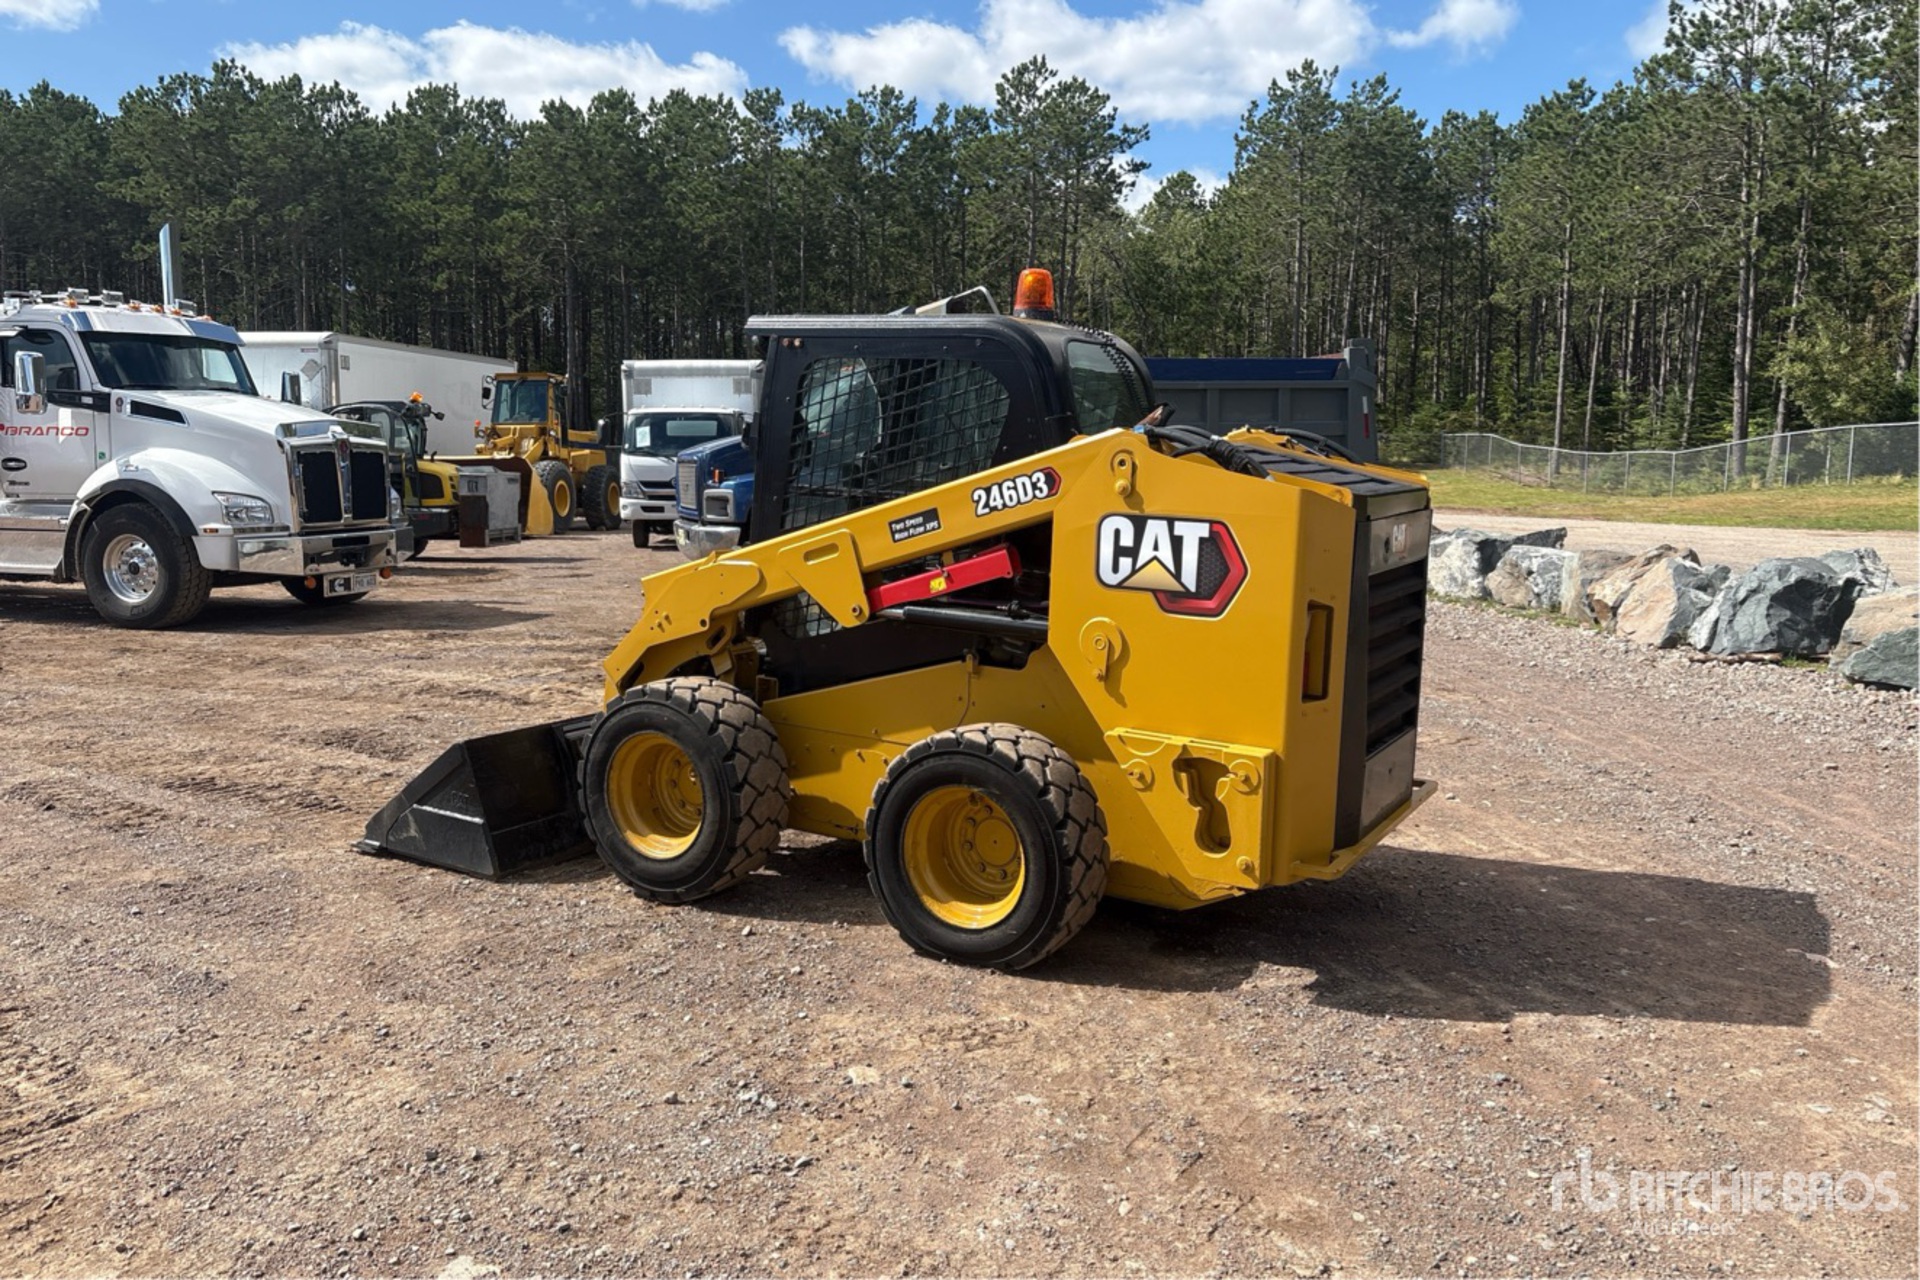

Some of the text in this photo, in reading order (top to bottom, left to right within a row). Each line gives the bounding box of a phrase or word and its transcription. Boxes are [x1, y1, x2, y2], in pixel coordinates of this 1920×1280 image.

[4, 426, 89, 437] BRANCO
[972, 471, 1049, 516] 246D3
[1098, 515, 1210, 593] CAT
